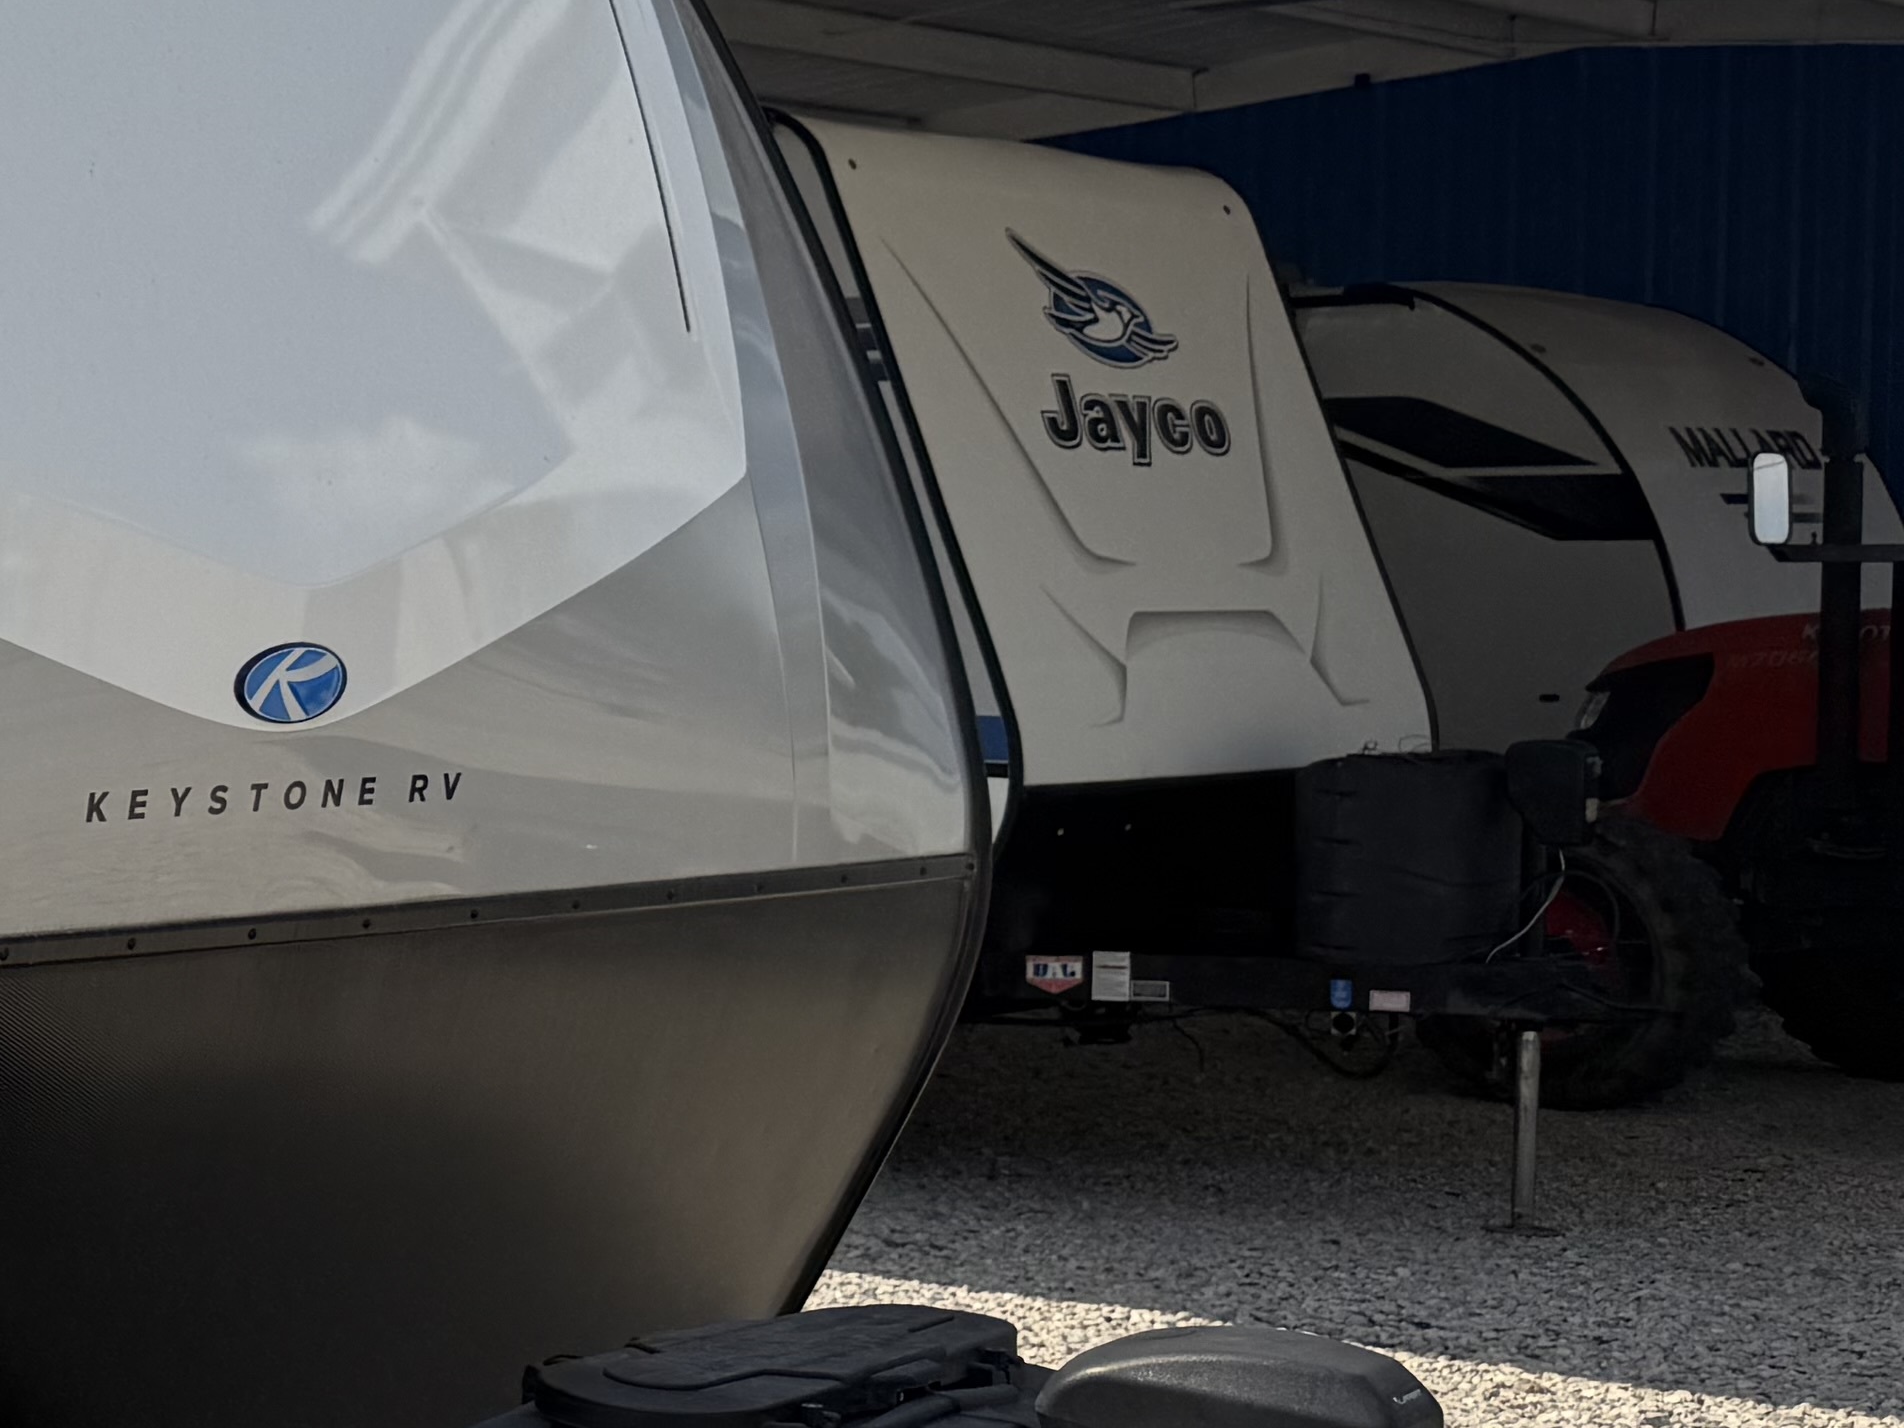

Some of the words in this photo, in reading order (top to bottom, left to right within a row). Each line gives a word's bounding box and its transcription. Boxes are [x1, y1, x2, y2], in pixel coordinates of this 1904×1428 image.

[1041, 373, 1231, 467] Jayco
[85, 776, 377, 823] KEYSTONE
[408, 772, 462, 804] RV
